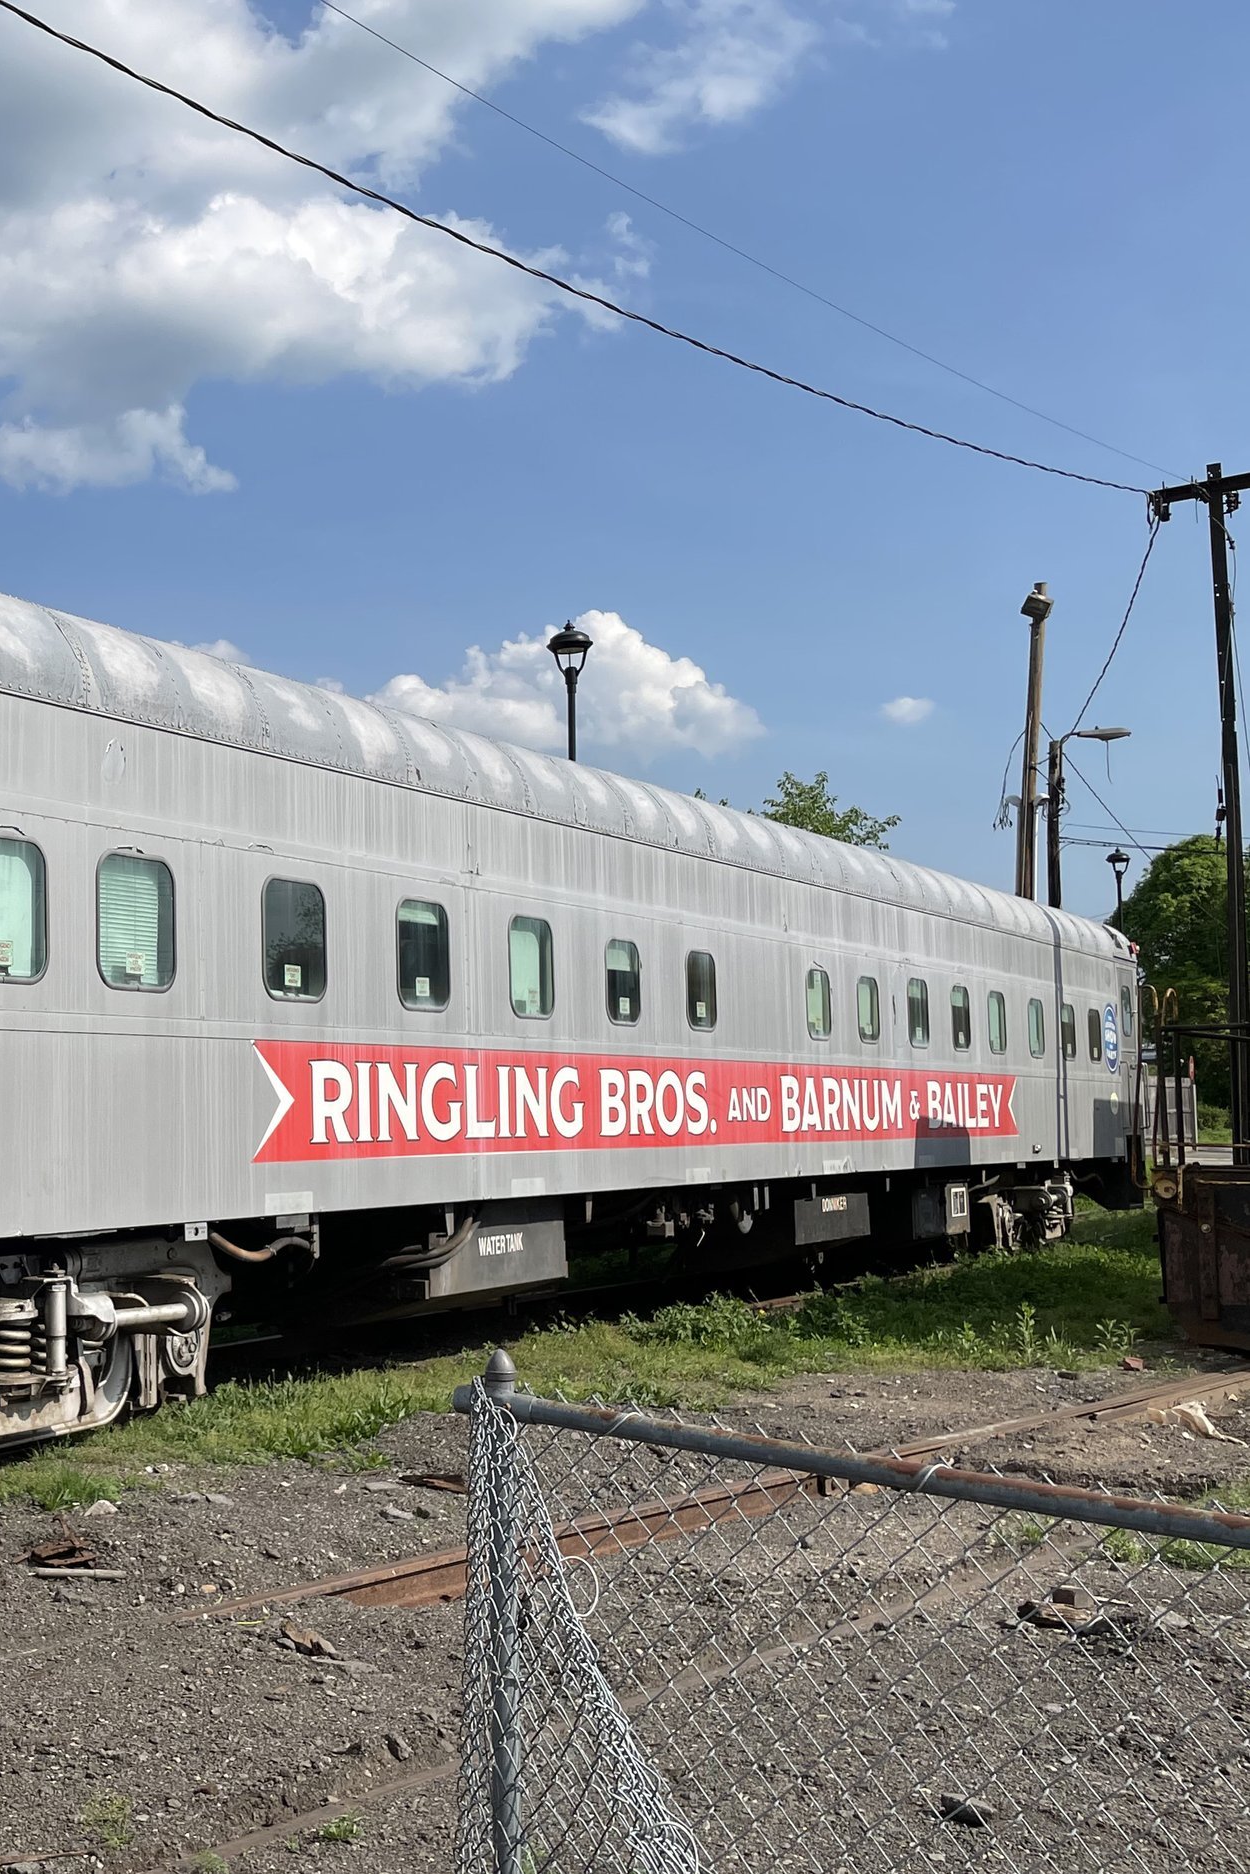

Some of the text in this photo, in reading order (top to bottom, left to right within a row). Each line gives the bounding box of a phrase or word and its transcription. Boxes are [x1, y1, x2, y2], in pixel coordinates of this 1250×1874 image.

[308, 1058, 1003, 1144] RINGLING BROS. AND BARNUM & BAILEY
[478, 1231, 524, 1257] WATER TANK
